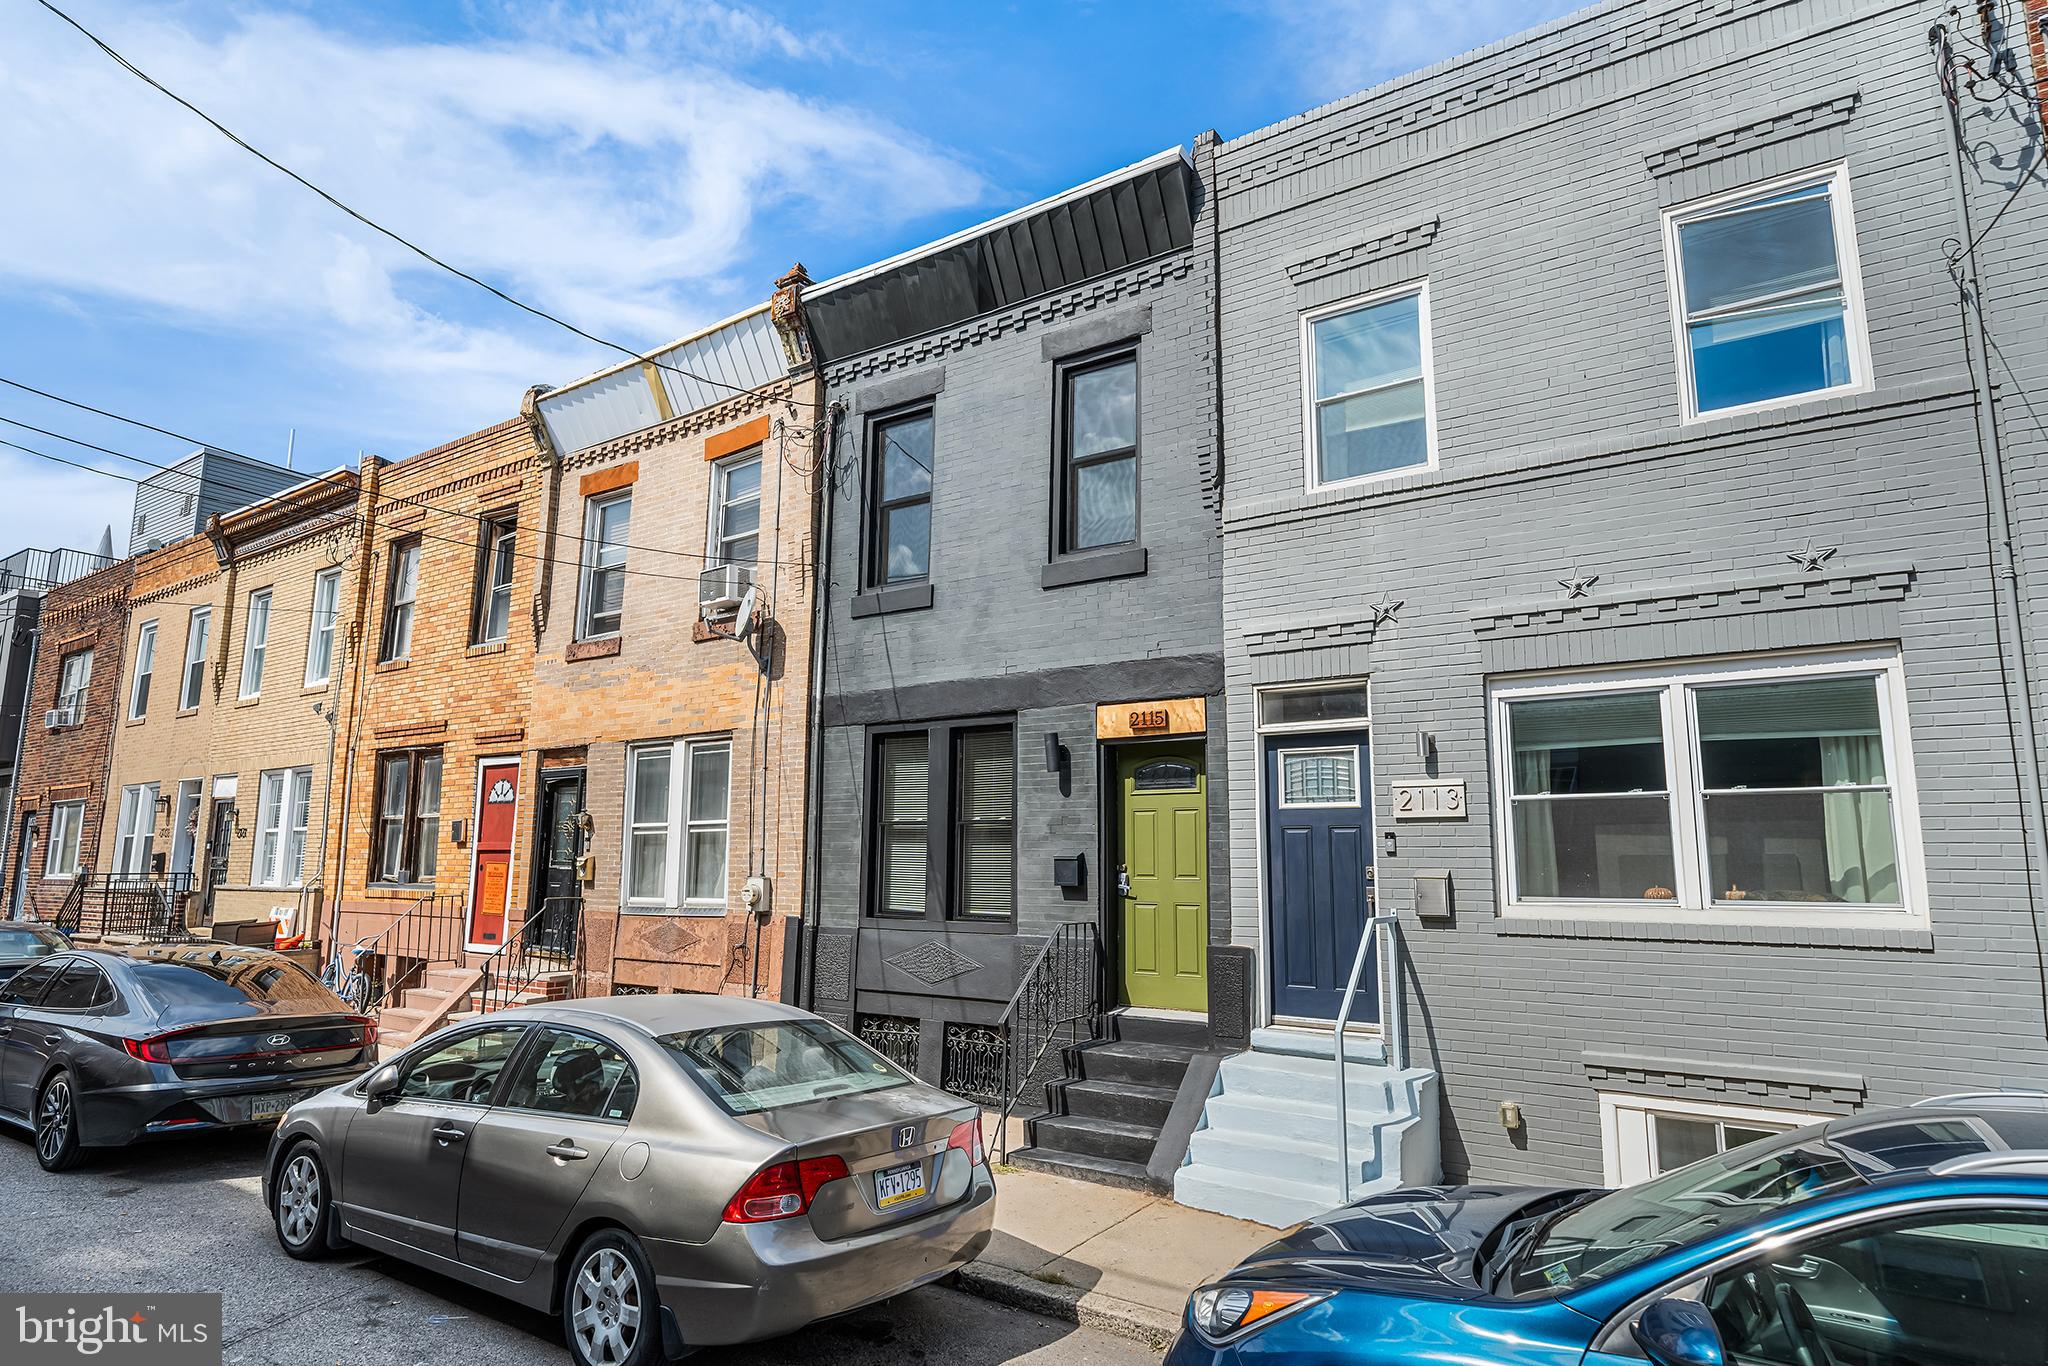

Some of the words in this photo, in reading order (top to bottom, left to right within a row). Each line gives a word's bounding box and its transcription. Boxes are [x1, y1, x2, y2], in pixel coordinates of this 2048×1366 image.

[1130, 710, 1164, 726] 2115
[1400, 788, 1459, 811] 2113
[228, 1057, 322, 1070] SONATA
